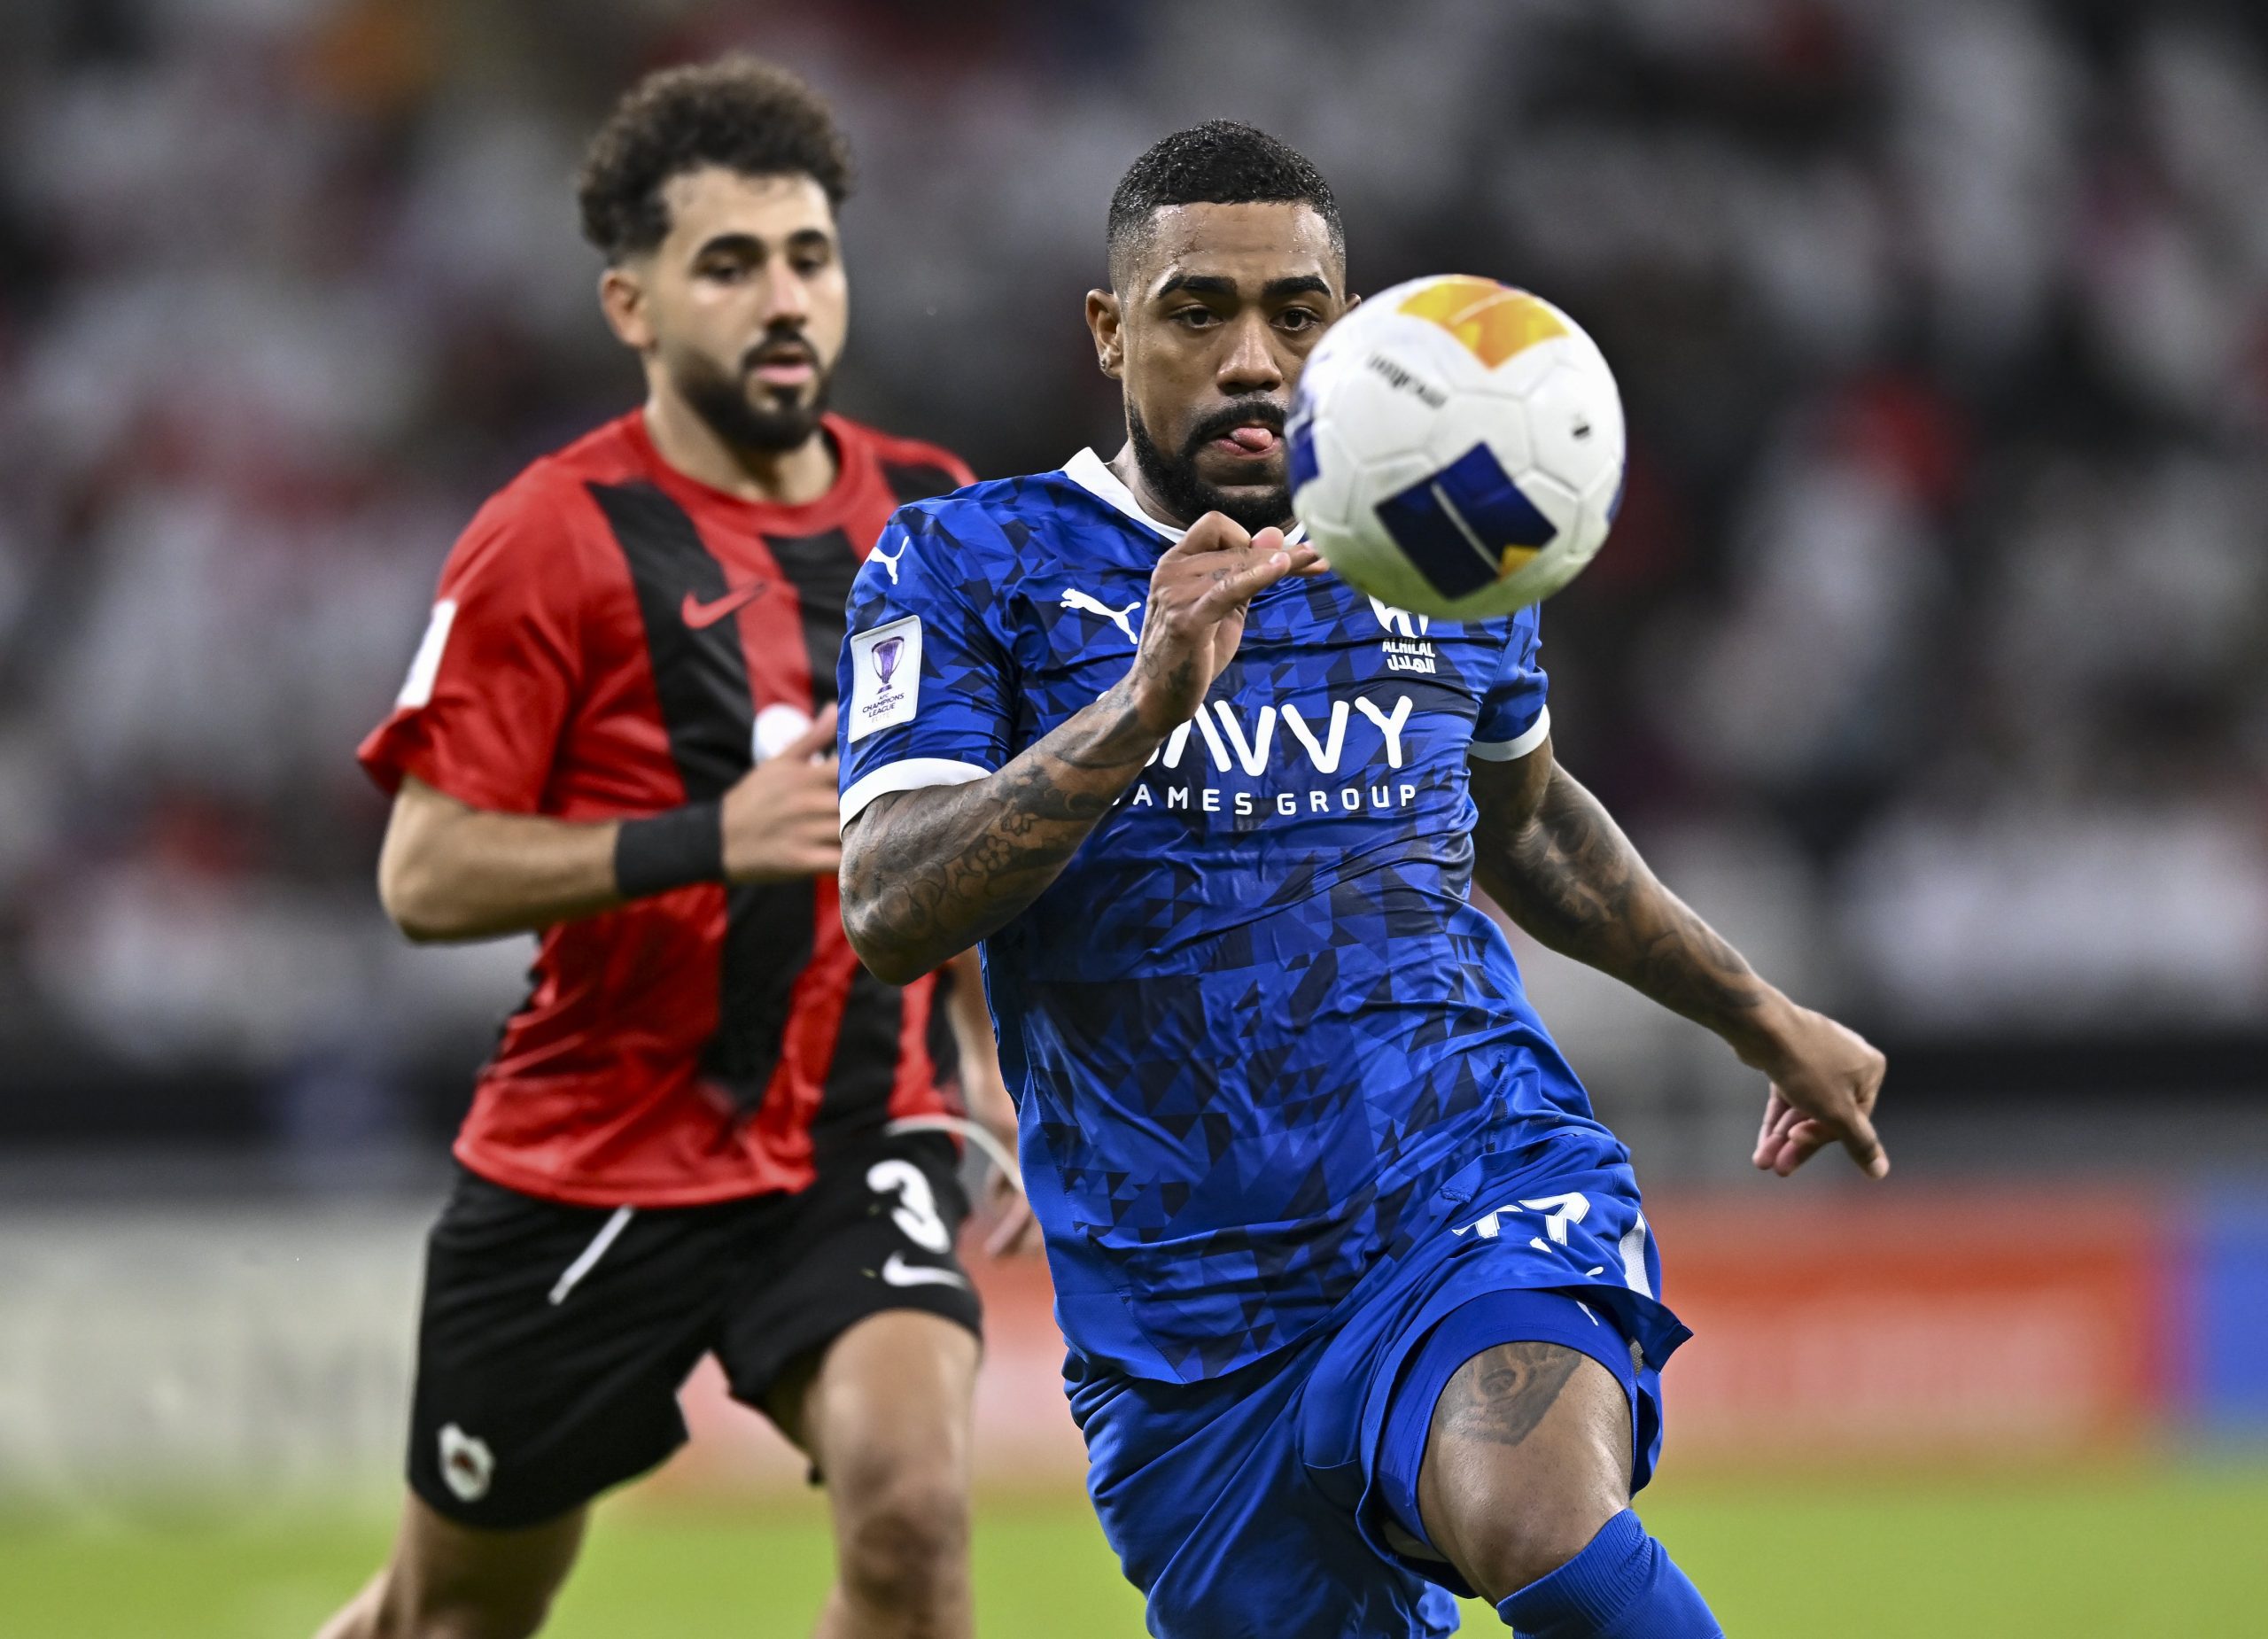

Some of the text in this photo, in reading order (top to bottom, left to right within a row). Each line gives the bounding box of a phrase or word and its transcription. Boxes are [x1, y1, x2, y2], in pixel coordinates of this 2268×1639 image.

[862, 692, 905, 713] CHAMPIONS
[868, 702, 896, 718] LEAGUE
[1145, 695, 1414, 777] AVVY
[1113, 783, 1417, 816] AMES GROUP
[866, 1159, 951, 1254] 3
